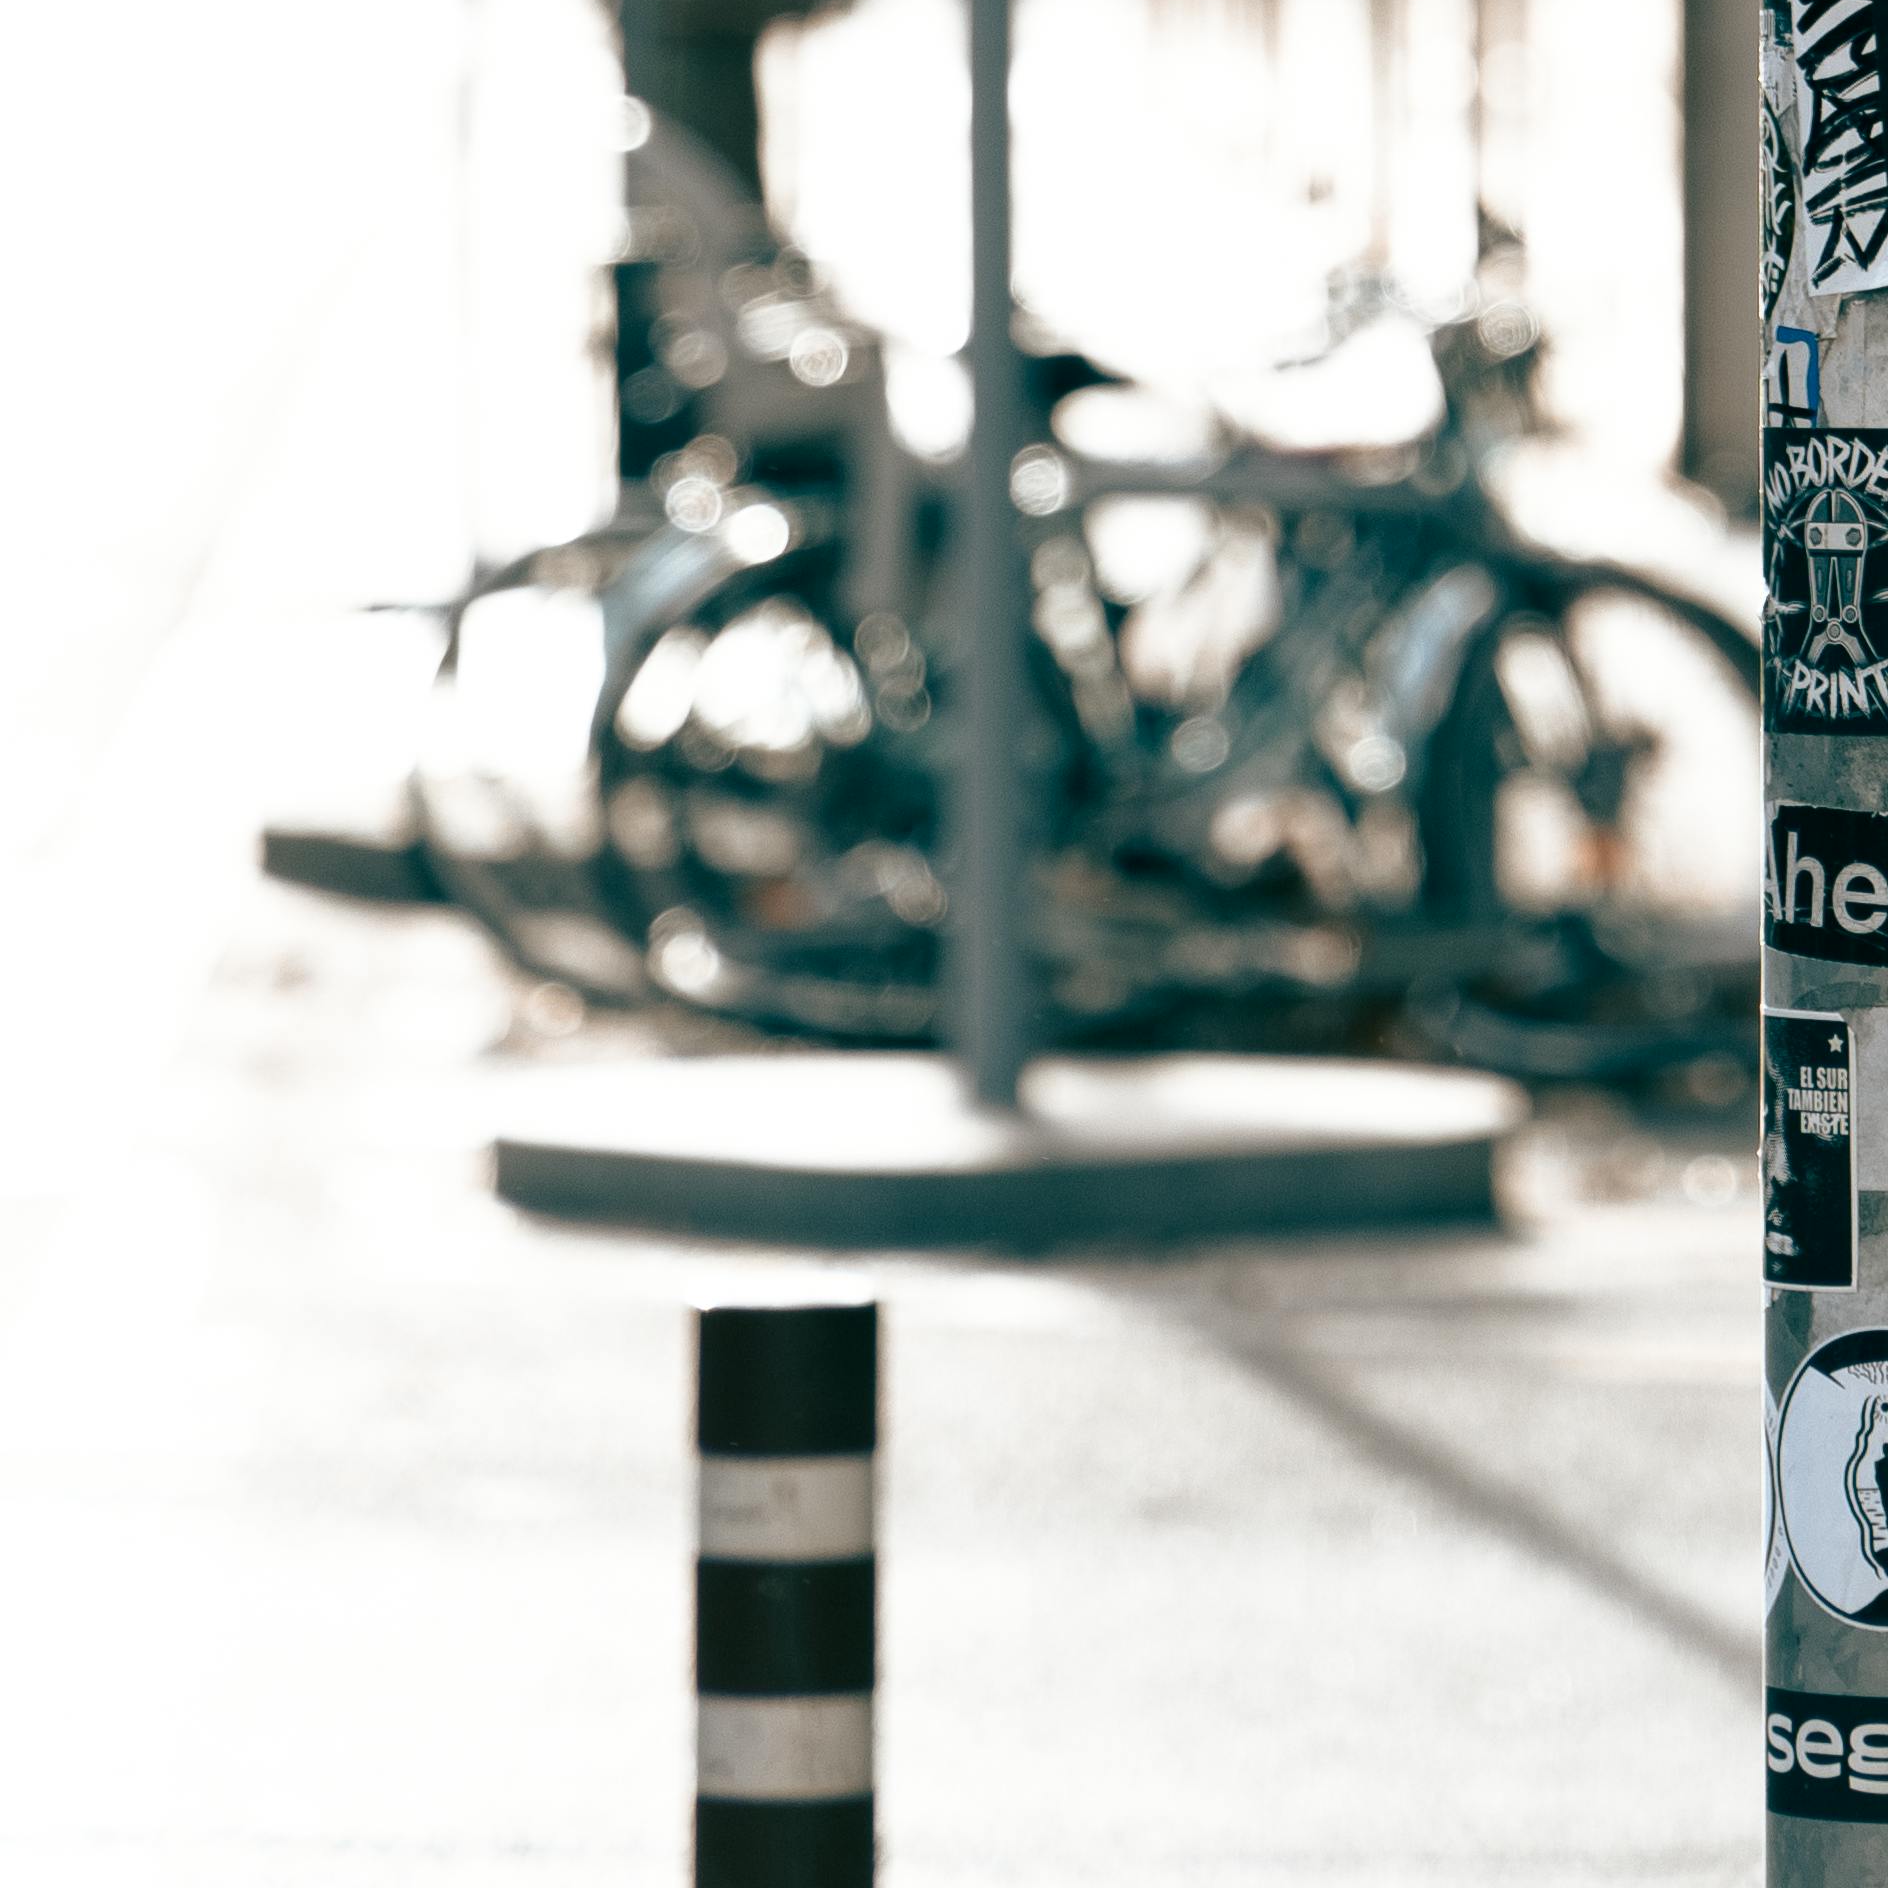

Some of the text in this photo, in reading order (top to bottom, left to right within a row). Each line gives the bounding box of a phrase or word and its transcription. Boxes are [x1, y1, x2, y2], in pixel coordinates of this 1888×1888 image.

[1765, 461, 1792, 521] NO
[1800, 1066, 1849, 1090] EL SUR
[1786, 1088, 1849, 1113] TAMBIEN
